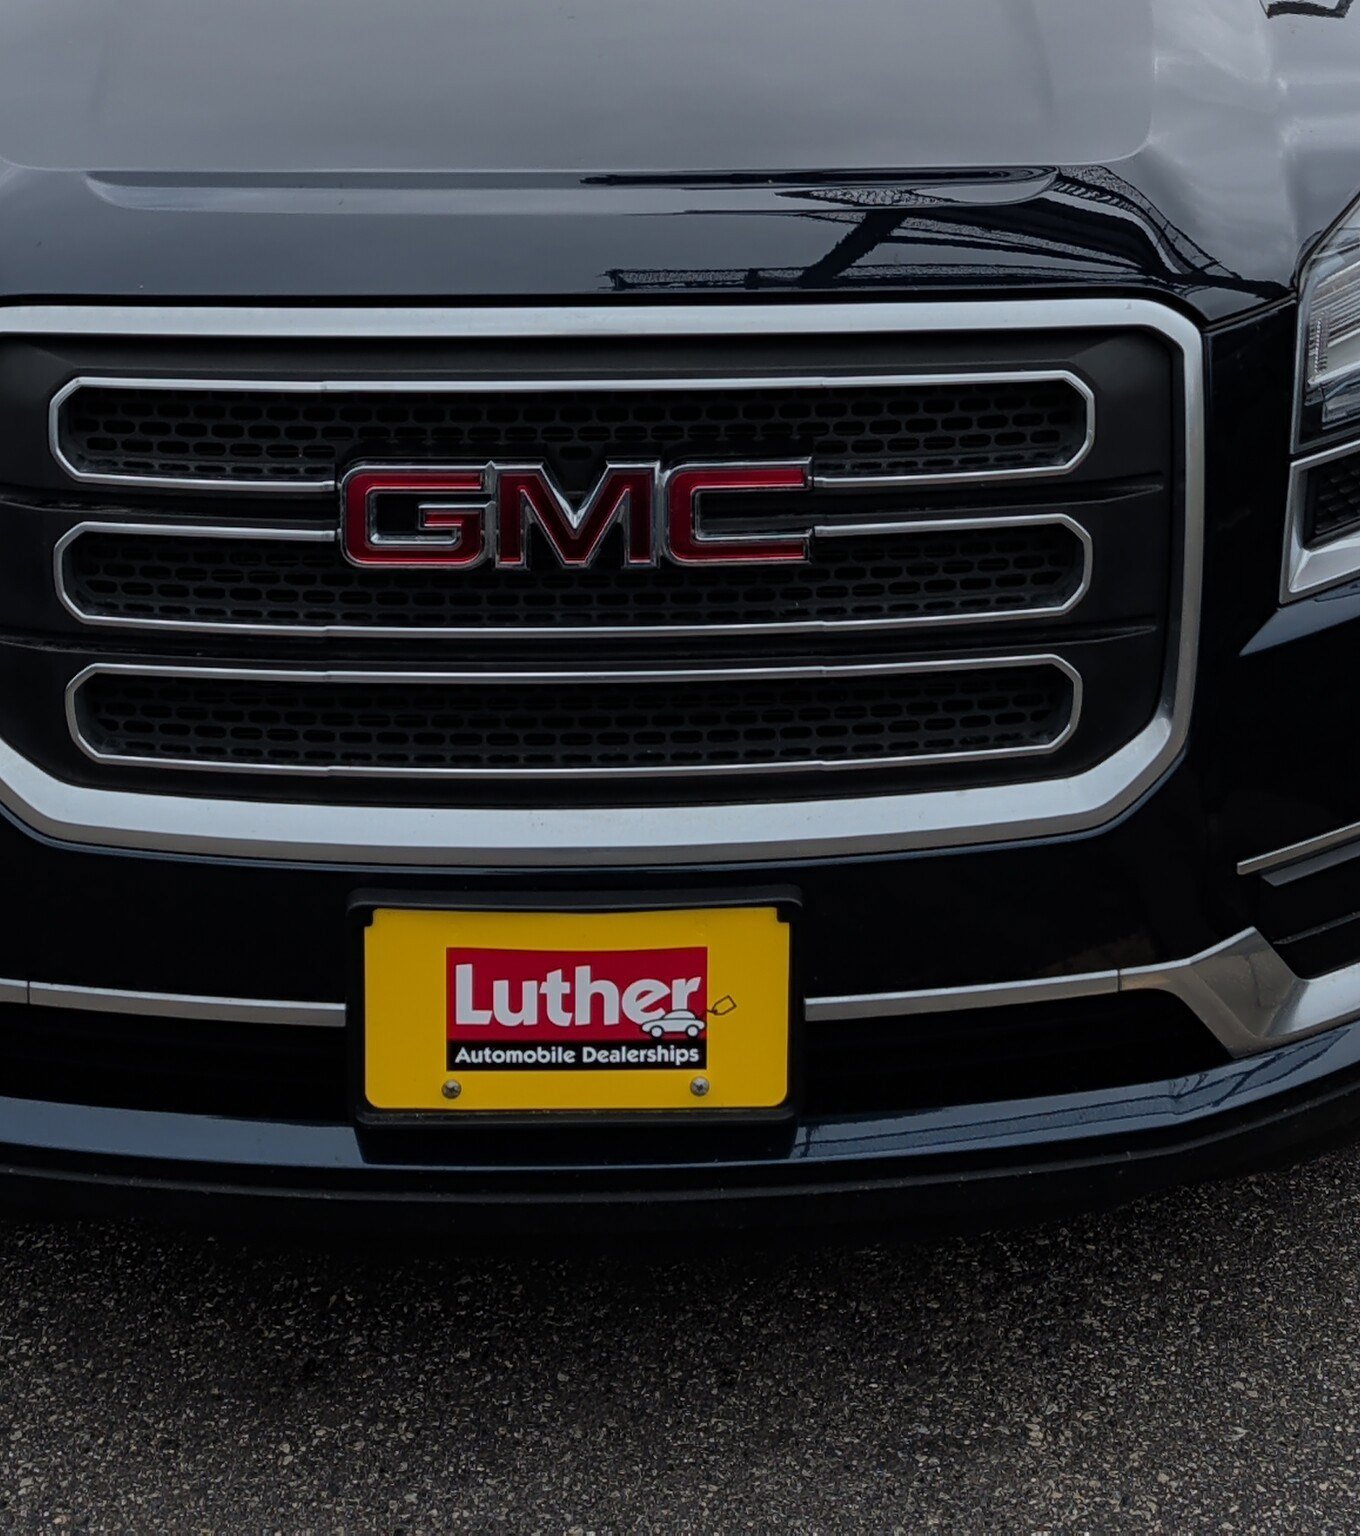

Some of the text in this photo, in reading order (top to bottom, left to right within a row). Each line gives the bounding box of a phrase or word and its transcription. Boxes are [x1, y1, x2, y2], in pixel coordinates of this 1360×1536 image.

[340, 457, 813, 570] GMC
[454, 963, 702, 1027] Luther
[454, 1045, 700, 1066] Automobile Dealerships
